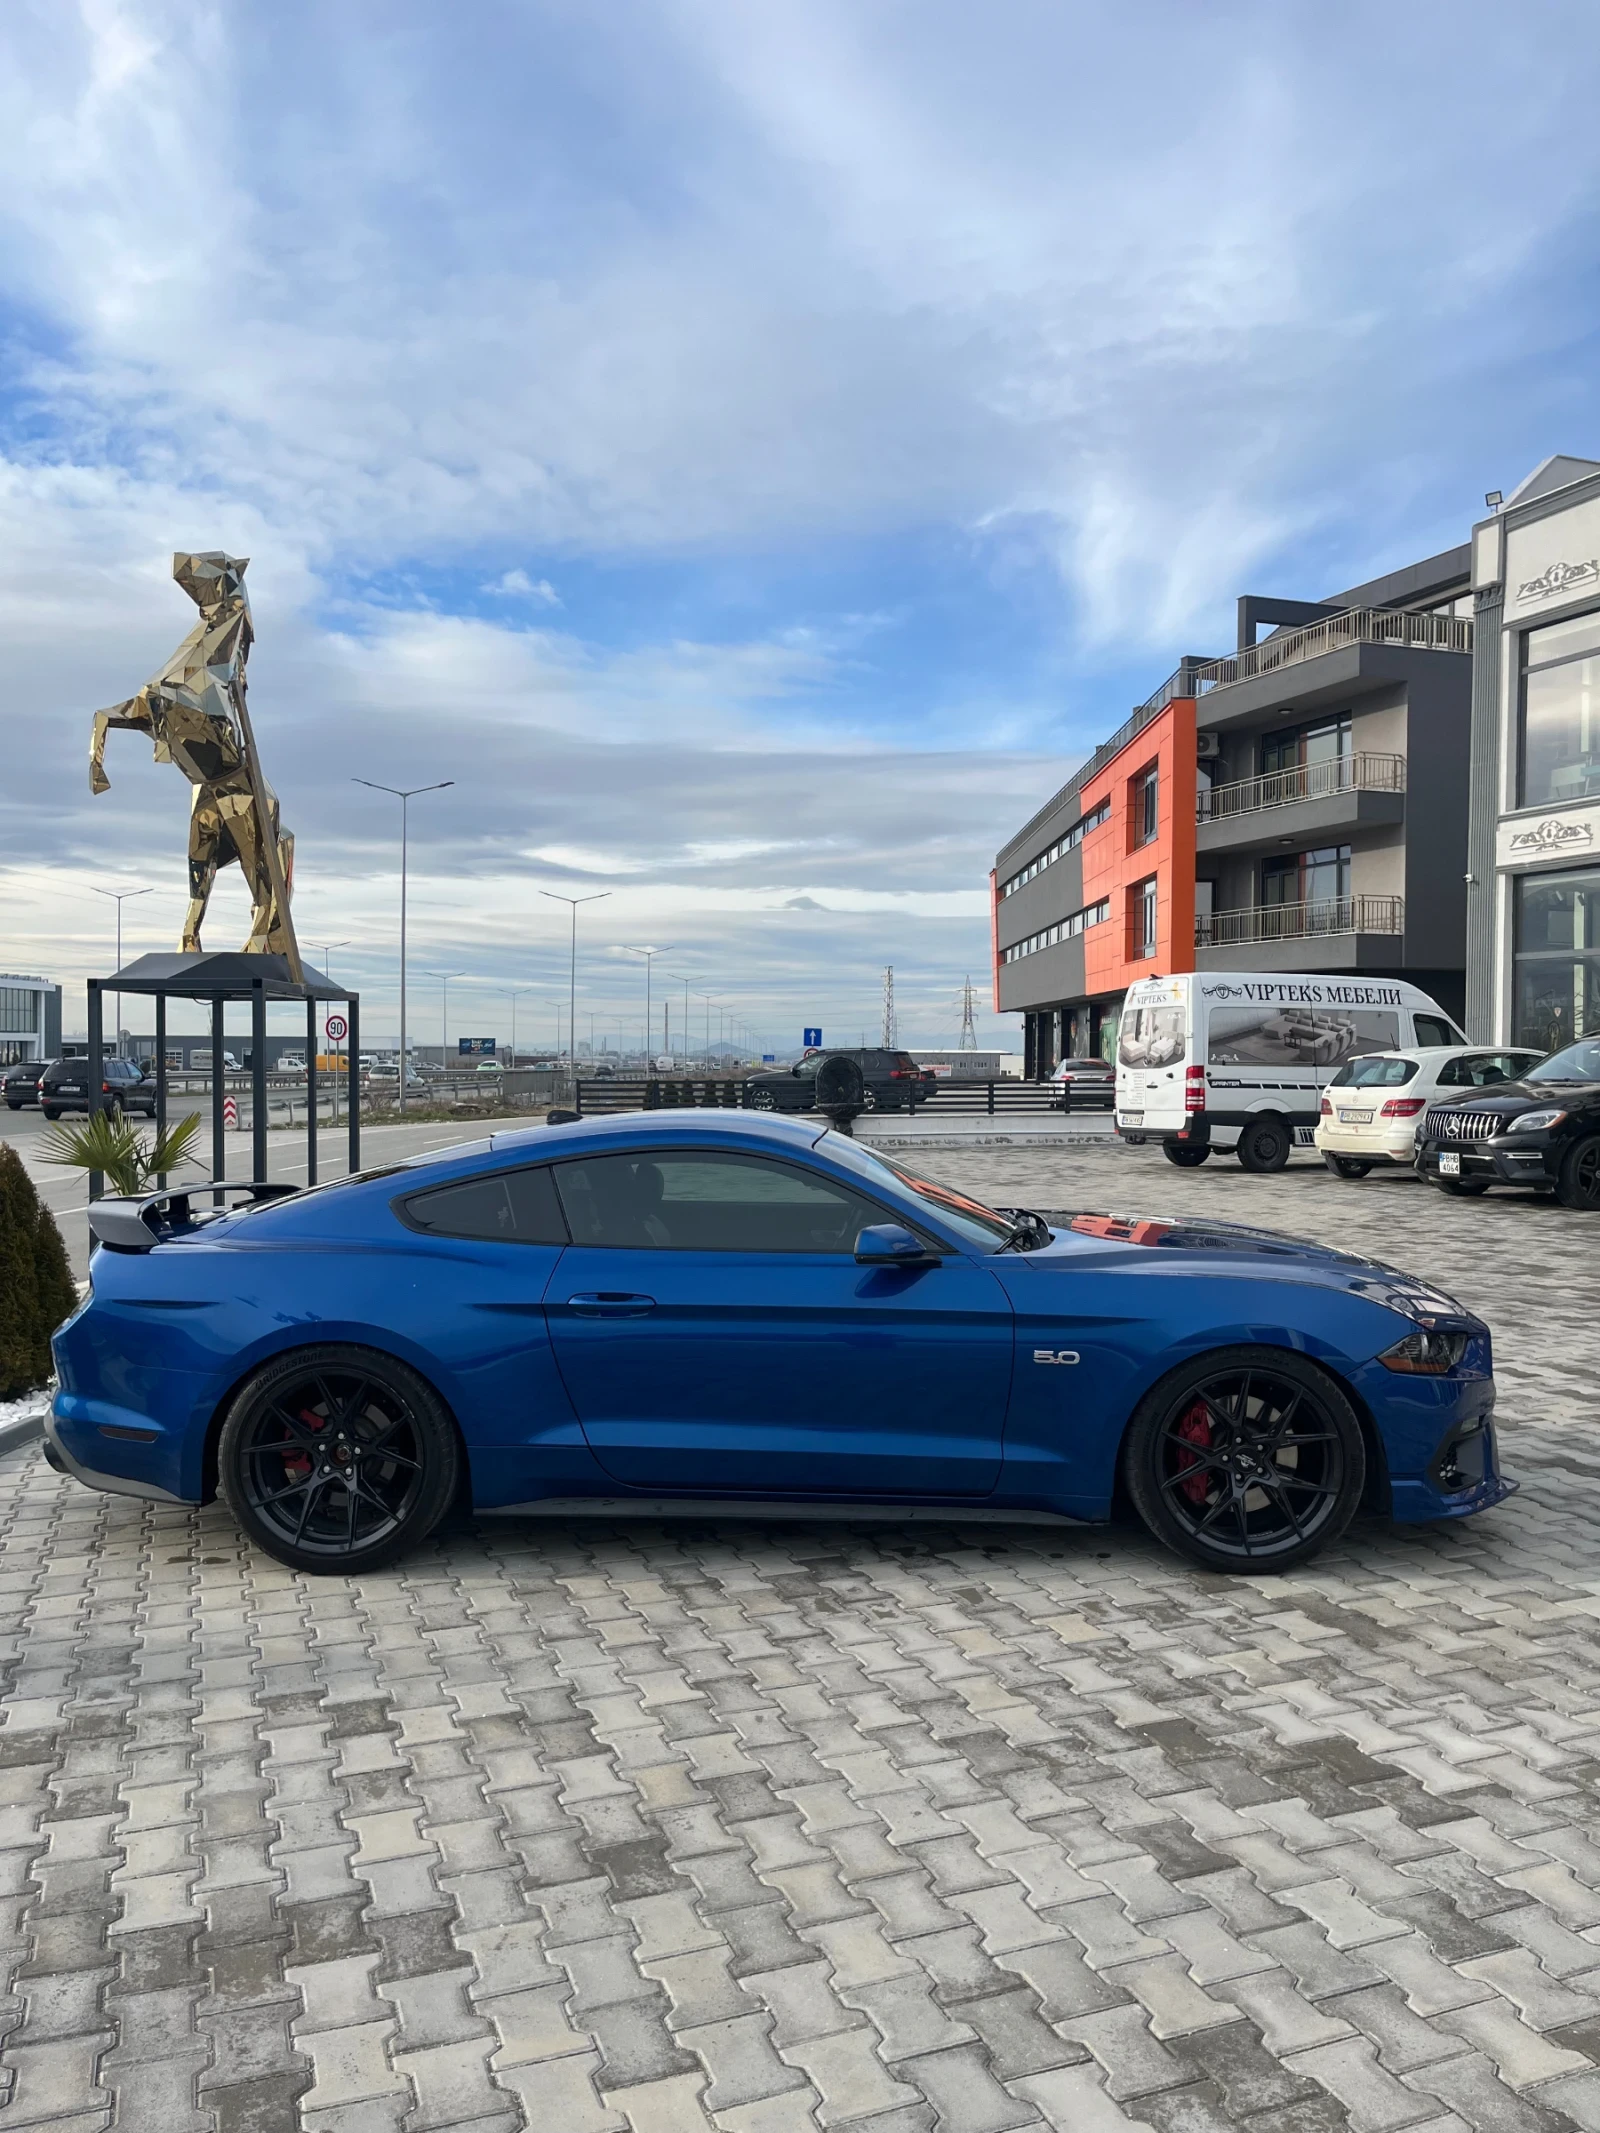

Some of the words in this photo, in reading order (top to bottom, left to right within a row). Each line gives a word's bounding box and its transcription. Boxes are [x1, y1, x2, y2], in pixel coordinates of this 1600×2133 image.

[1137, 994, 1167, 1005] VIPTEKS
[1243, 983, 1321, 1002] VIPTEKS
[1327, 986, 1402, 1005] МЕБЕЛИ
[330, 1021, 343, 1035] 90
[1033, 1349, 1080, 1364] 5.0
